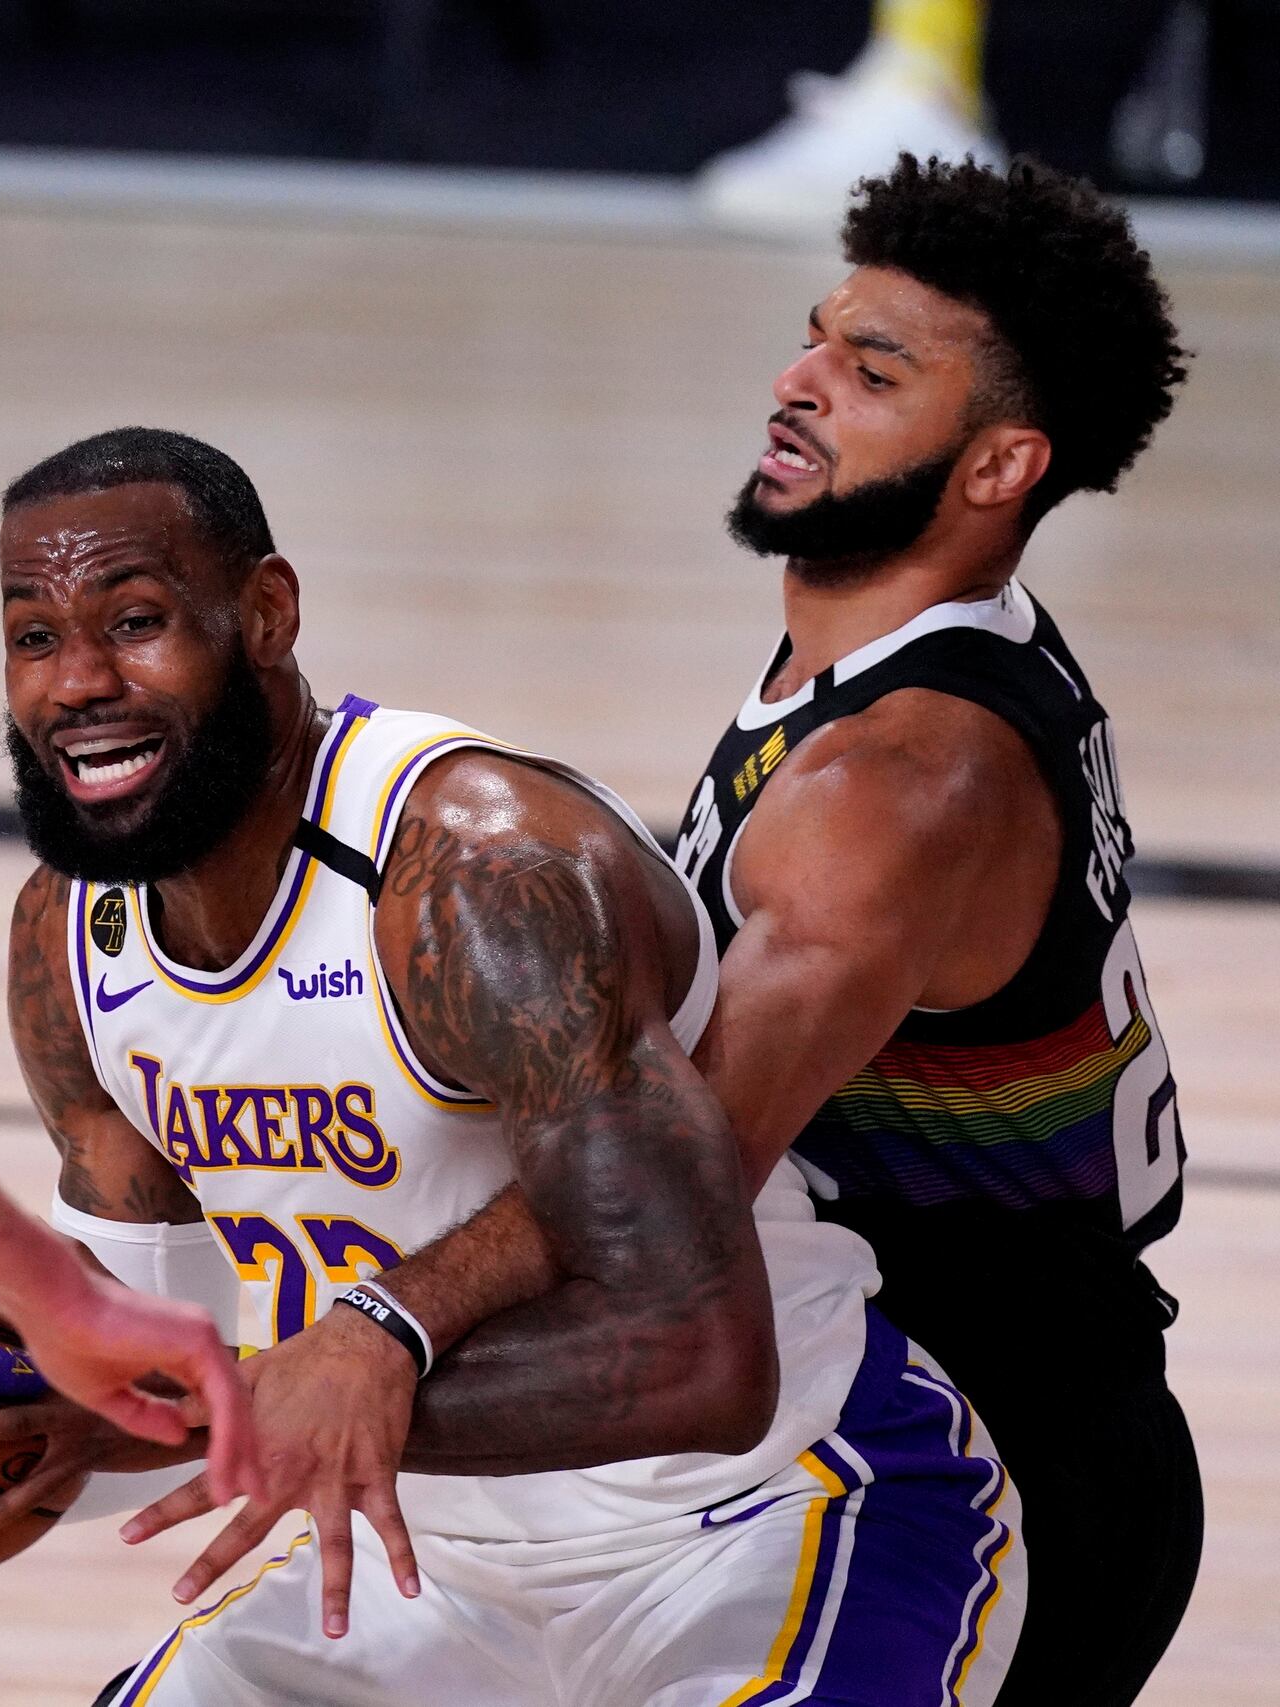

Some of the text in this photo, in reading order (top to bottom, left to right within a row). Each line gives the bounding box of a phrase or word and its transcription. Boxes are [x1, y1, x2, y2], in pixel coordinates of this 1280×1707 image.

[759, 724, 788, 776] WU
[278, 959, 363, 1001] wish
[128, 1049, 403, 1191] LAKERS
